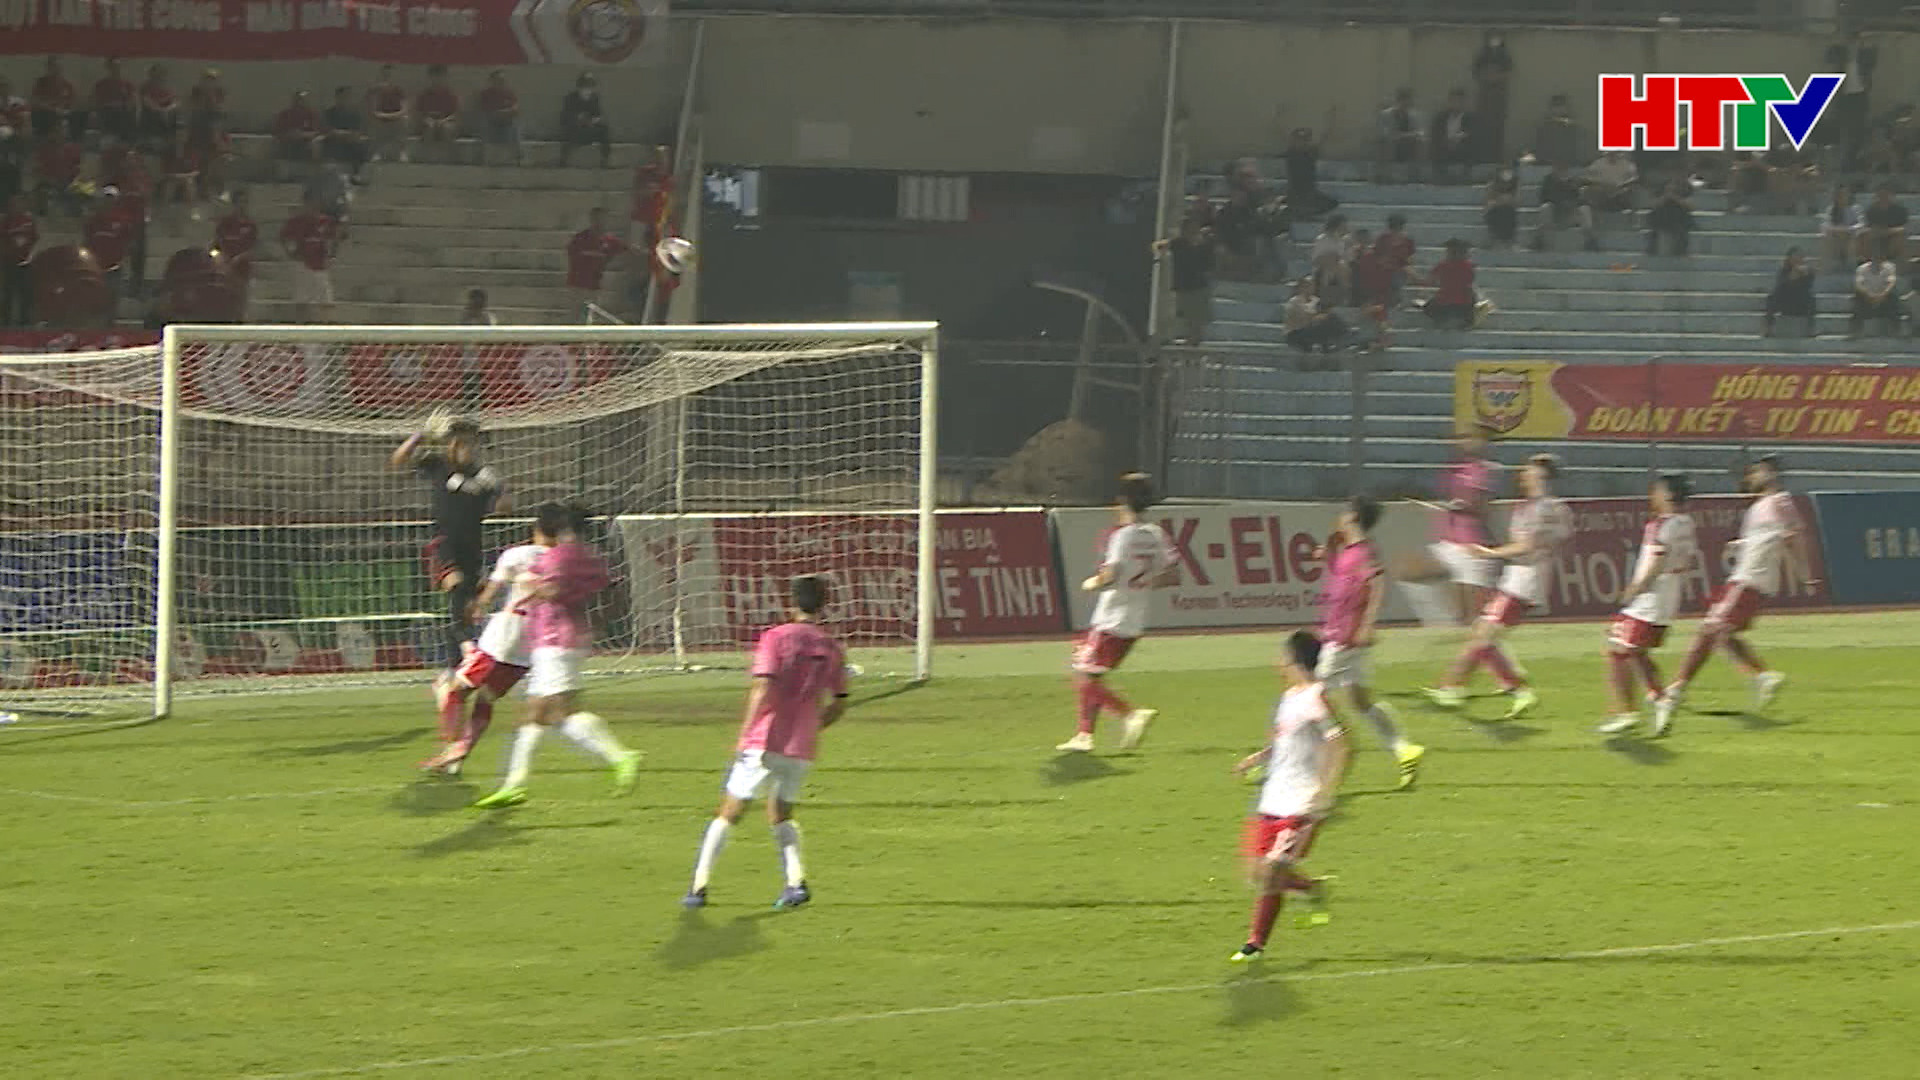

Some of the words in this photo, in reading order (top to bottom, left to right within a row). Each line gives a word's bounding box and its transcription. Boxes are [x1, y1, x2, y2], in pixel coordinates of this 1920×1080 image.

[1808, 409, 1863, 434] TIN
[963, 527, 998, 550] BIA
[970, 554, 1055, 618] TĨNH
